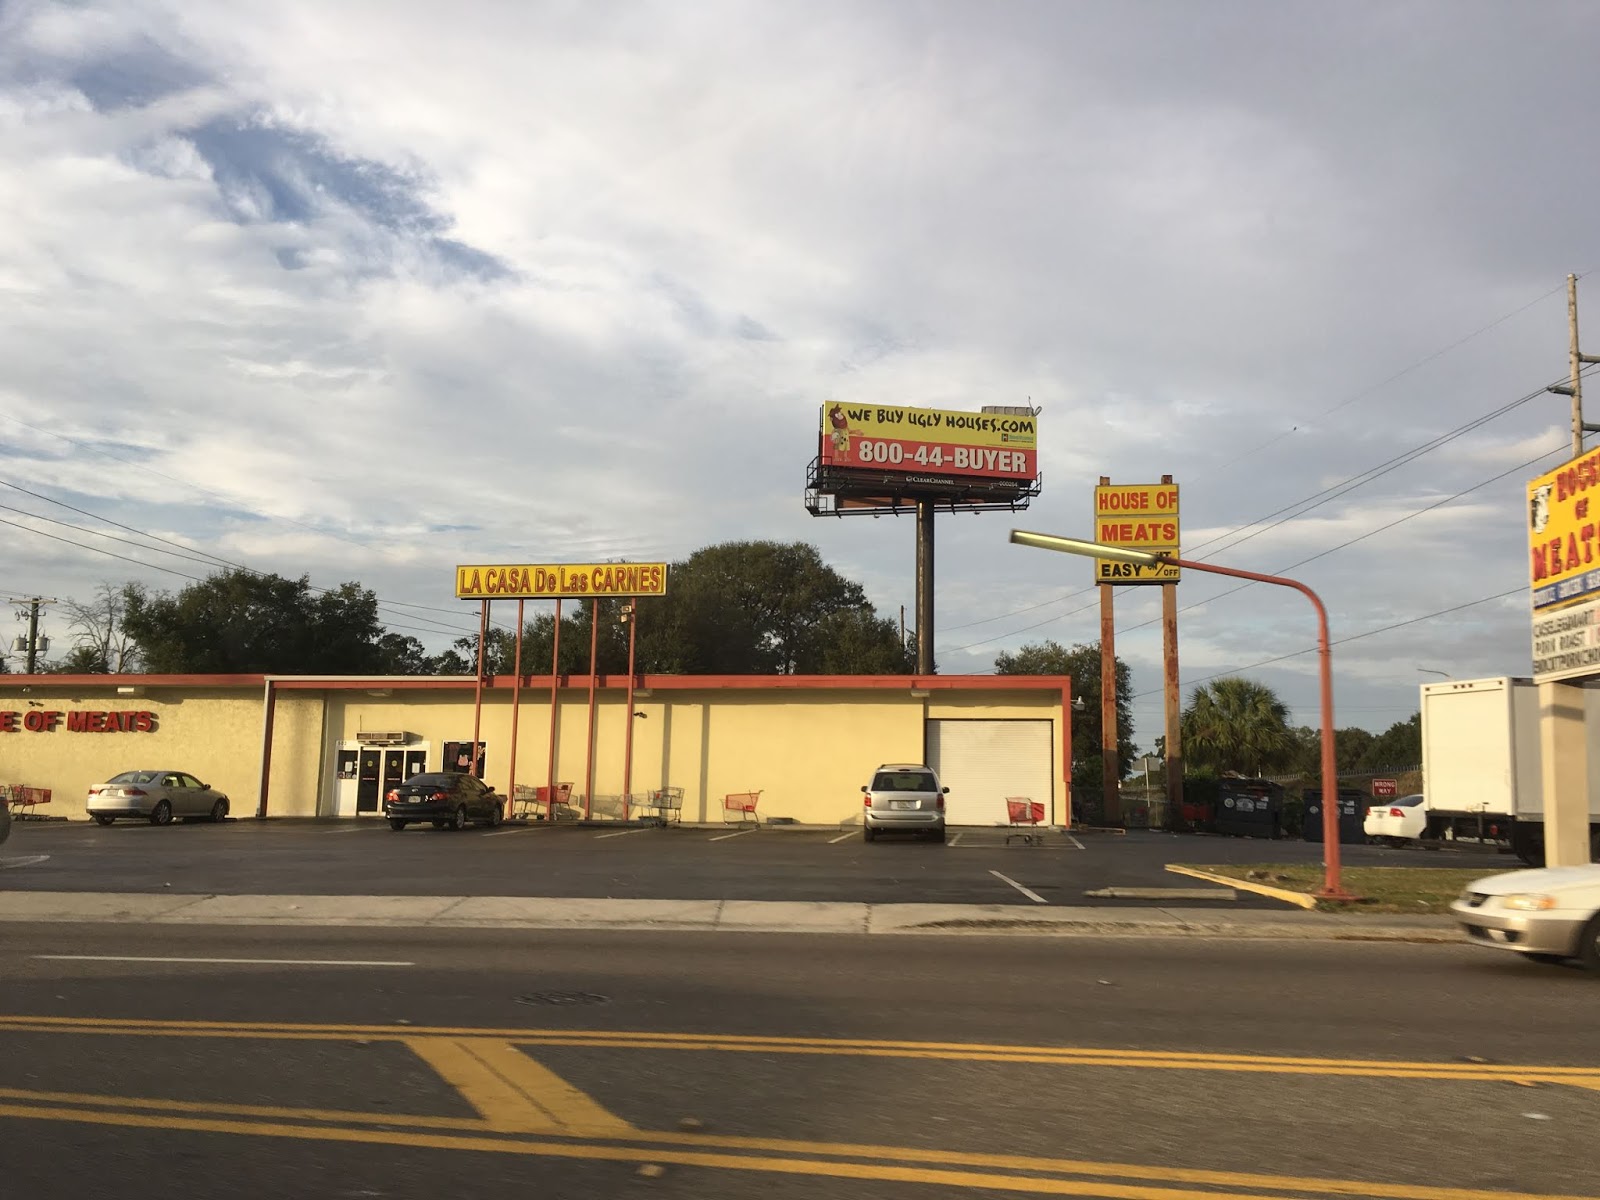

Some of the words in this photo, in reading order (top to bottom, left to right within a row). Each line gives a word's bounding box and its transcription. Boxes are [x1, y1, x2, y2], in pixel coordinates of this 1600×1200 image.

[847, 409, 872, 422] WE
[877, 409, 904, 424] BUY
[908, 412, 941, 427] UGLY
[946, 416, 1034, 434] HOUSES.COM
[858, 440, 1027, 473] 800-44-BUYER
[1556, 452, 1600, 503] HOUS
[1099, 492, 1149, 510] HOUSE
[1156, 491, 1177, 509] OF
[1101, 523, 1176, 542] MEATS
[1532, 521, 1600, 582] MEAT
[460, 569, 482, 594] LA
[485, 568, 532, 594] CASA
[535, 568, 557, 593] De
[560, 568, 588, 593] Las
[591, 566, 662, 593] CARNES
[1101, 564, 1142, 577] EASY
[24, 711, 58, 732] OF
[67, 711, 152, 733] MEATS
